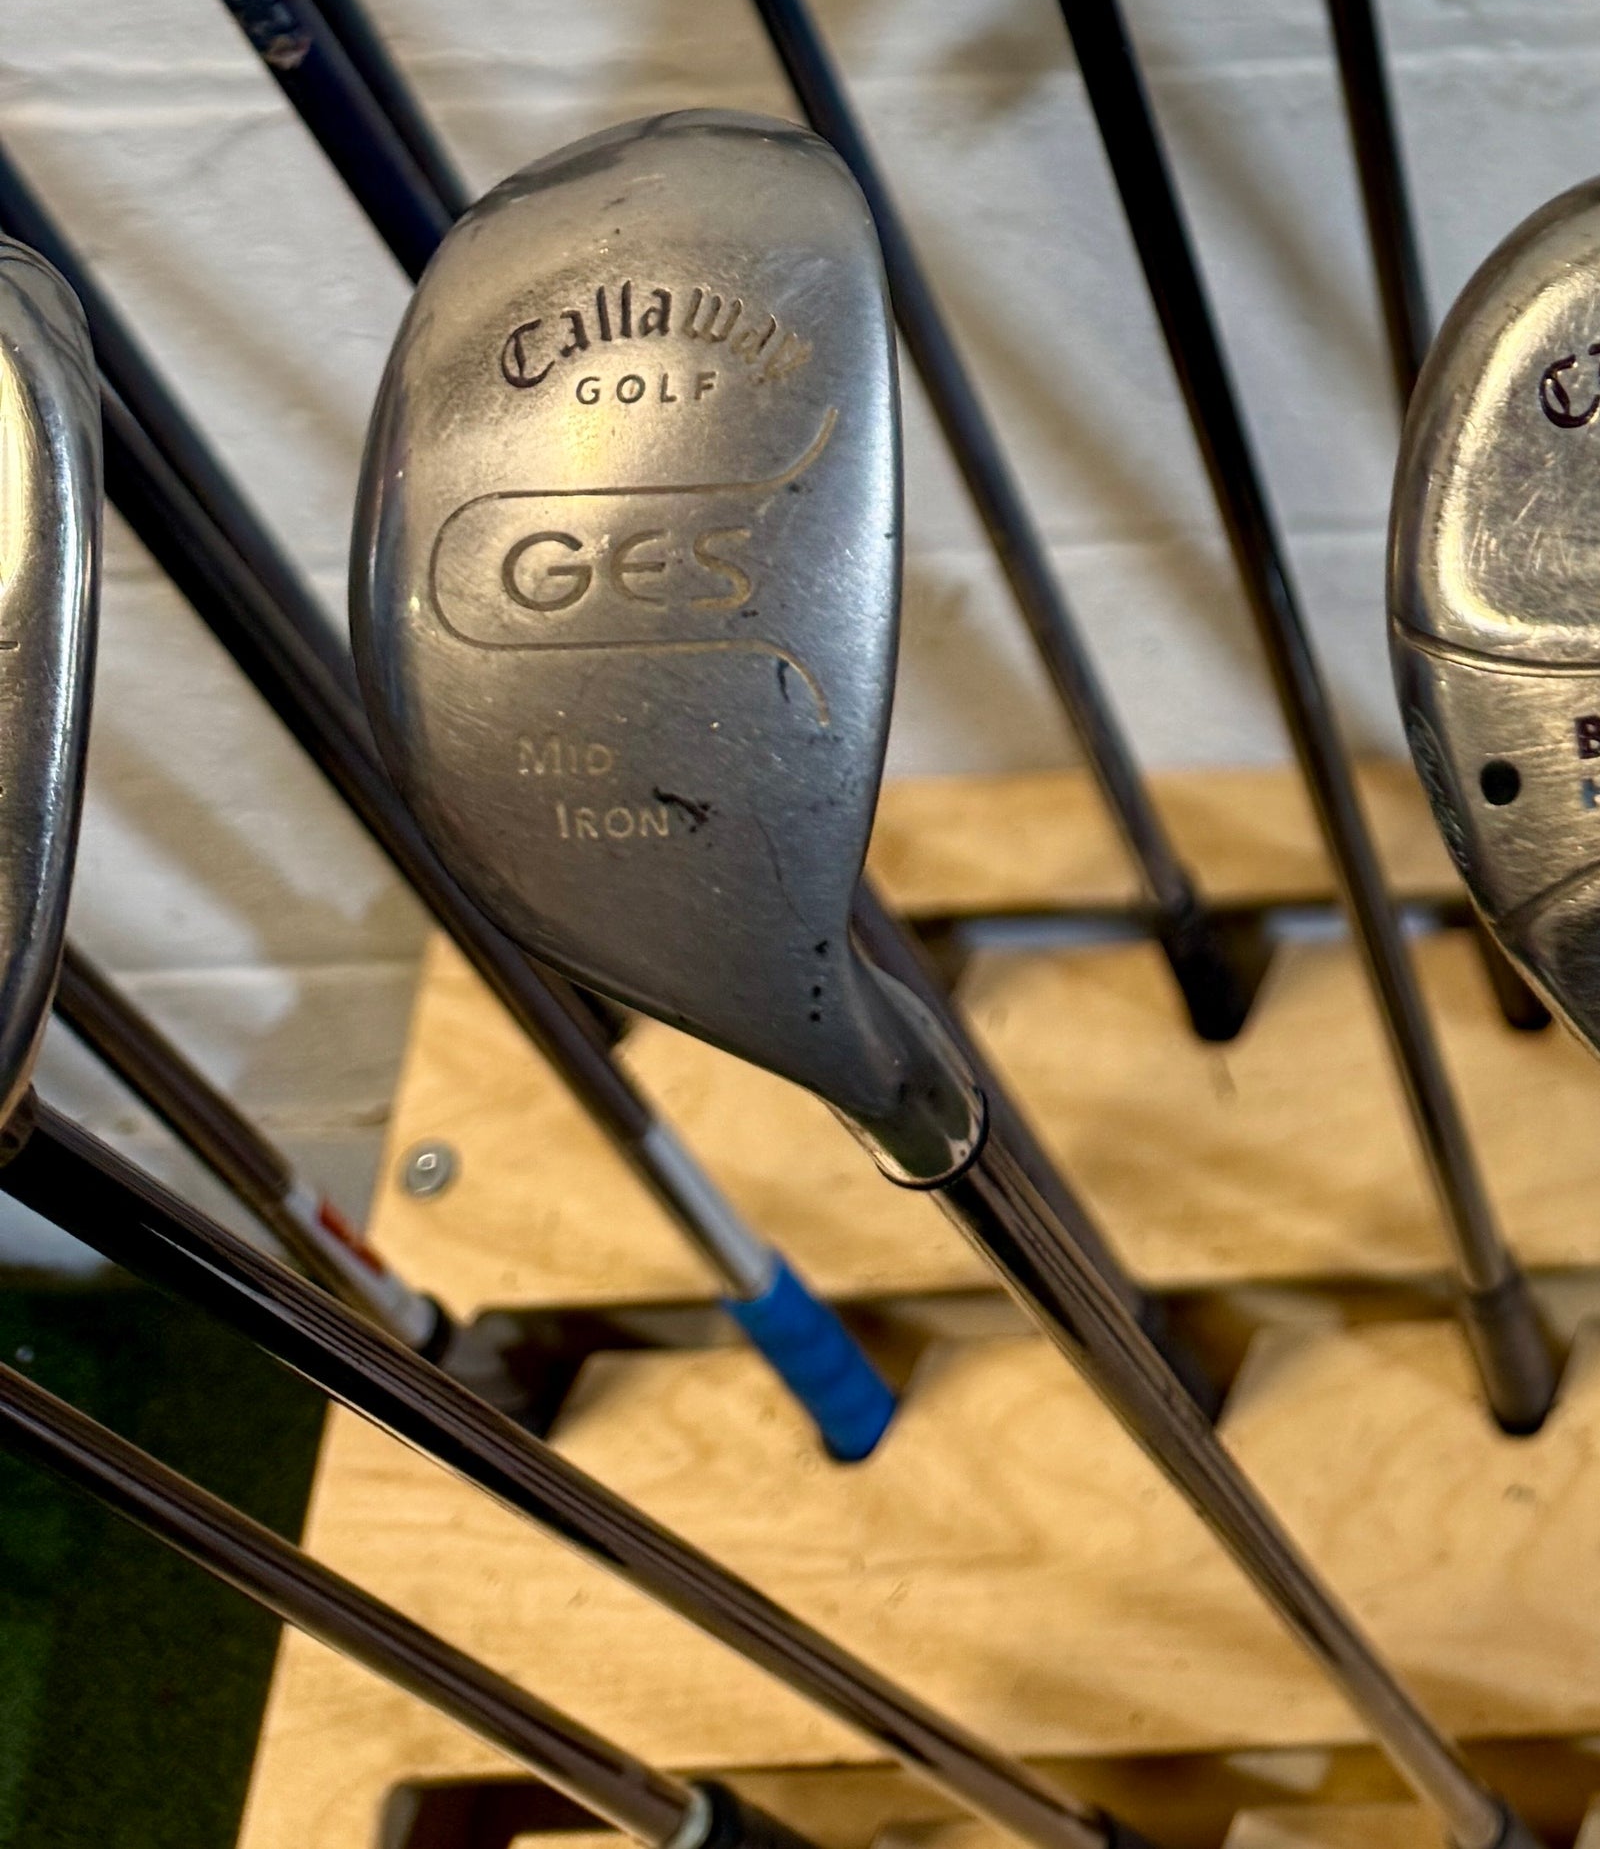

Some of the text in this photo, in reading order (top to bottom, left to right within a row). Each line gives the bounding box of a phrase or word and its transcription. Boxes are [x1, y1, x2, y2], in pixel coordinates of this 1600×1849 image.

[501, 278, 813, 388] Callaway
[576, 370, 718, 405] GOLF
[501, 527, 755, 613] GES
